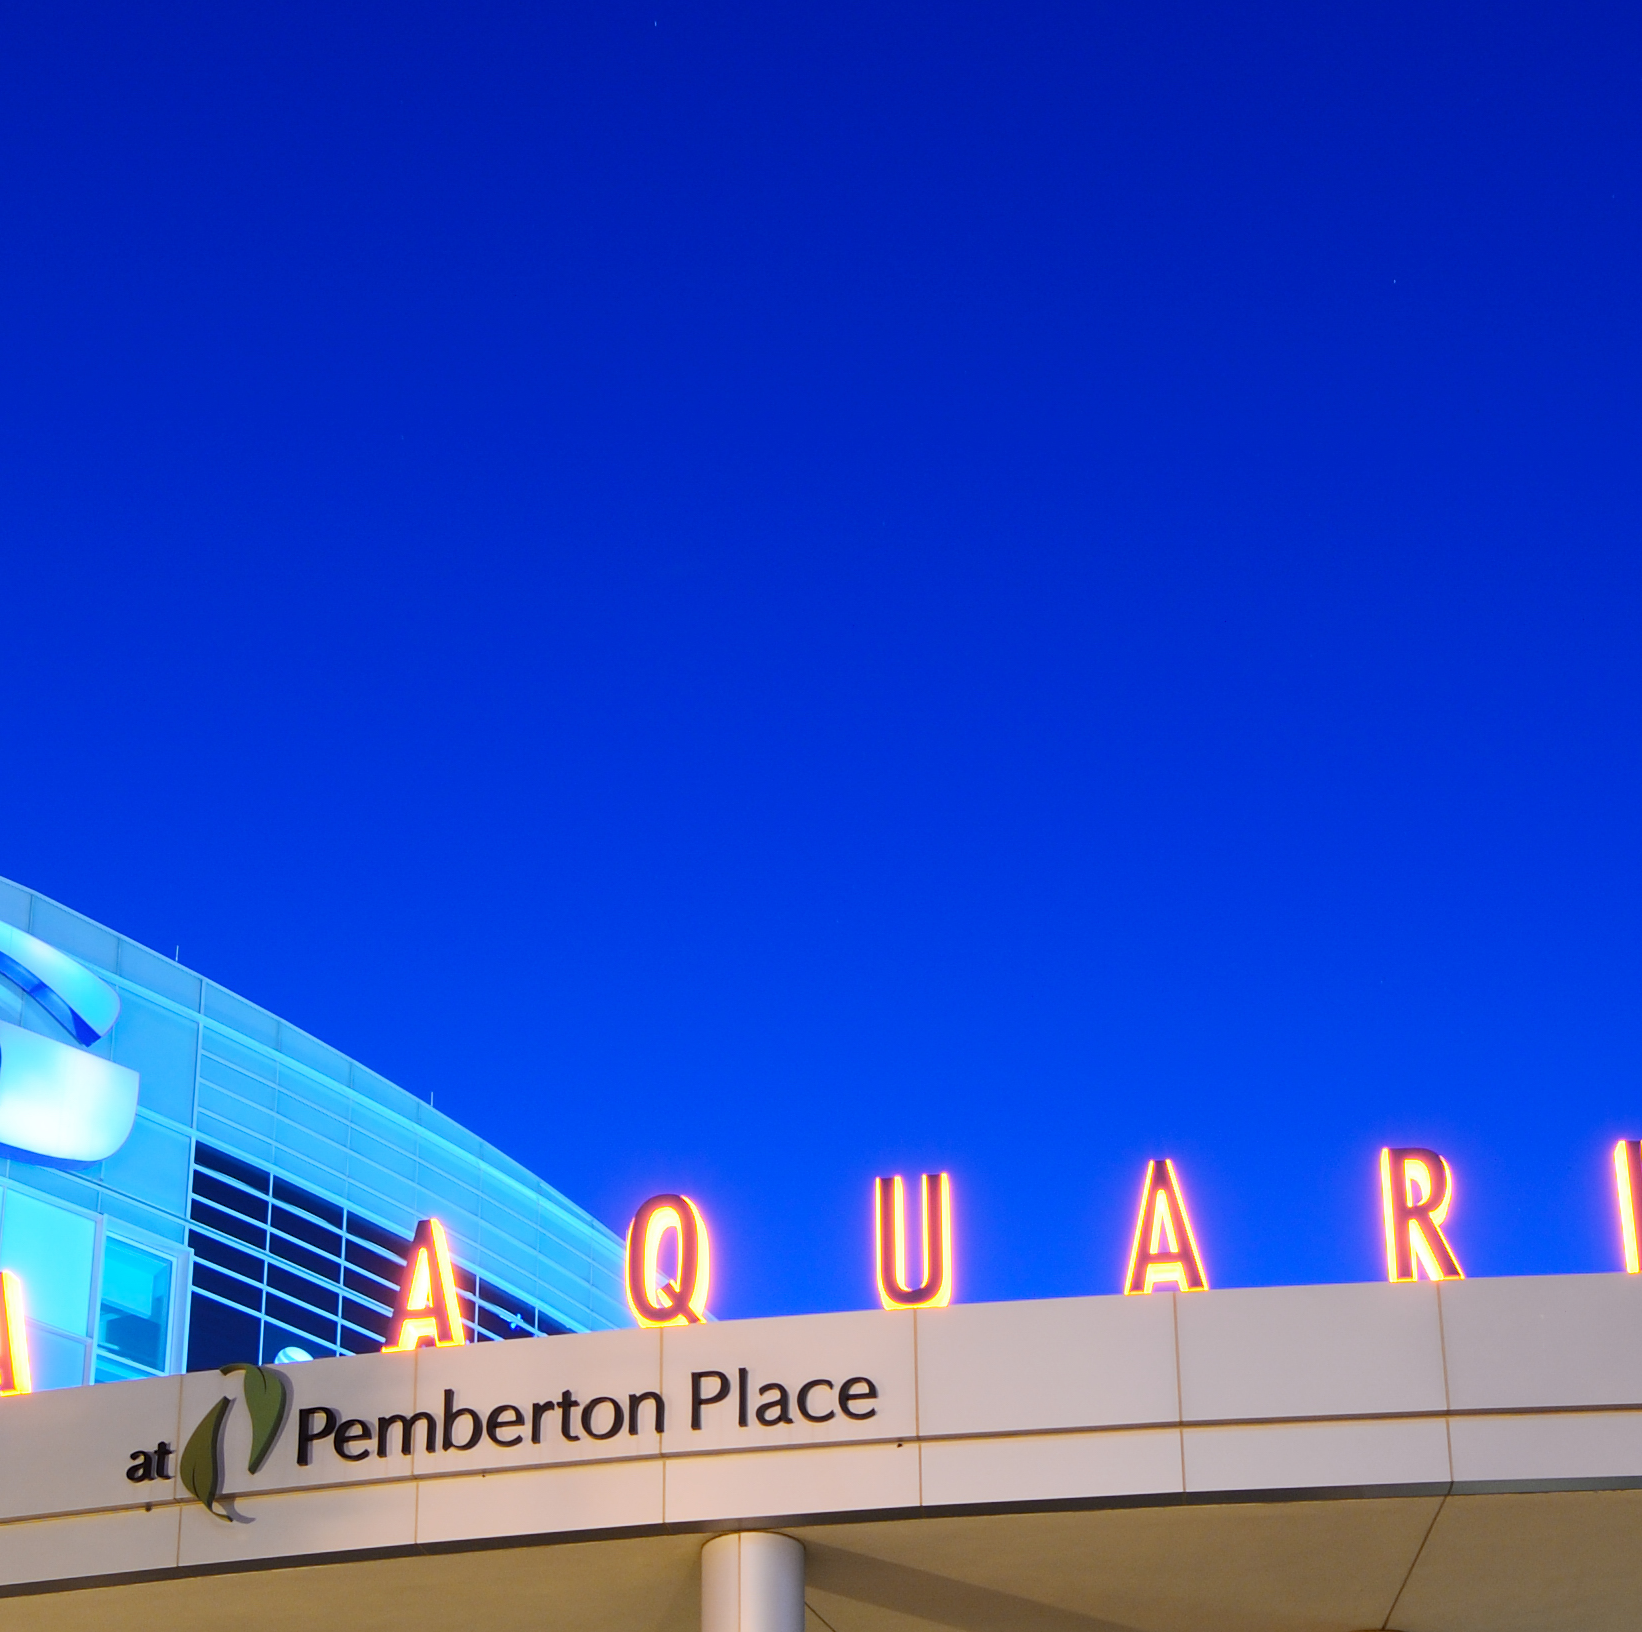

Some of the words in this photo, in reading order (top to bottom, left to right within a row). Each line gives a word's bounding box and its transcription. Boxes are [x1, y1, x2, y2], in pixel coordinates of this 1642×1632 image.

[125, 1441, 172, 1483] at
[296, 1388, 666, 1466] Pemberton
[690, 1367, 878, 1431] Place
